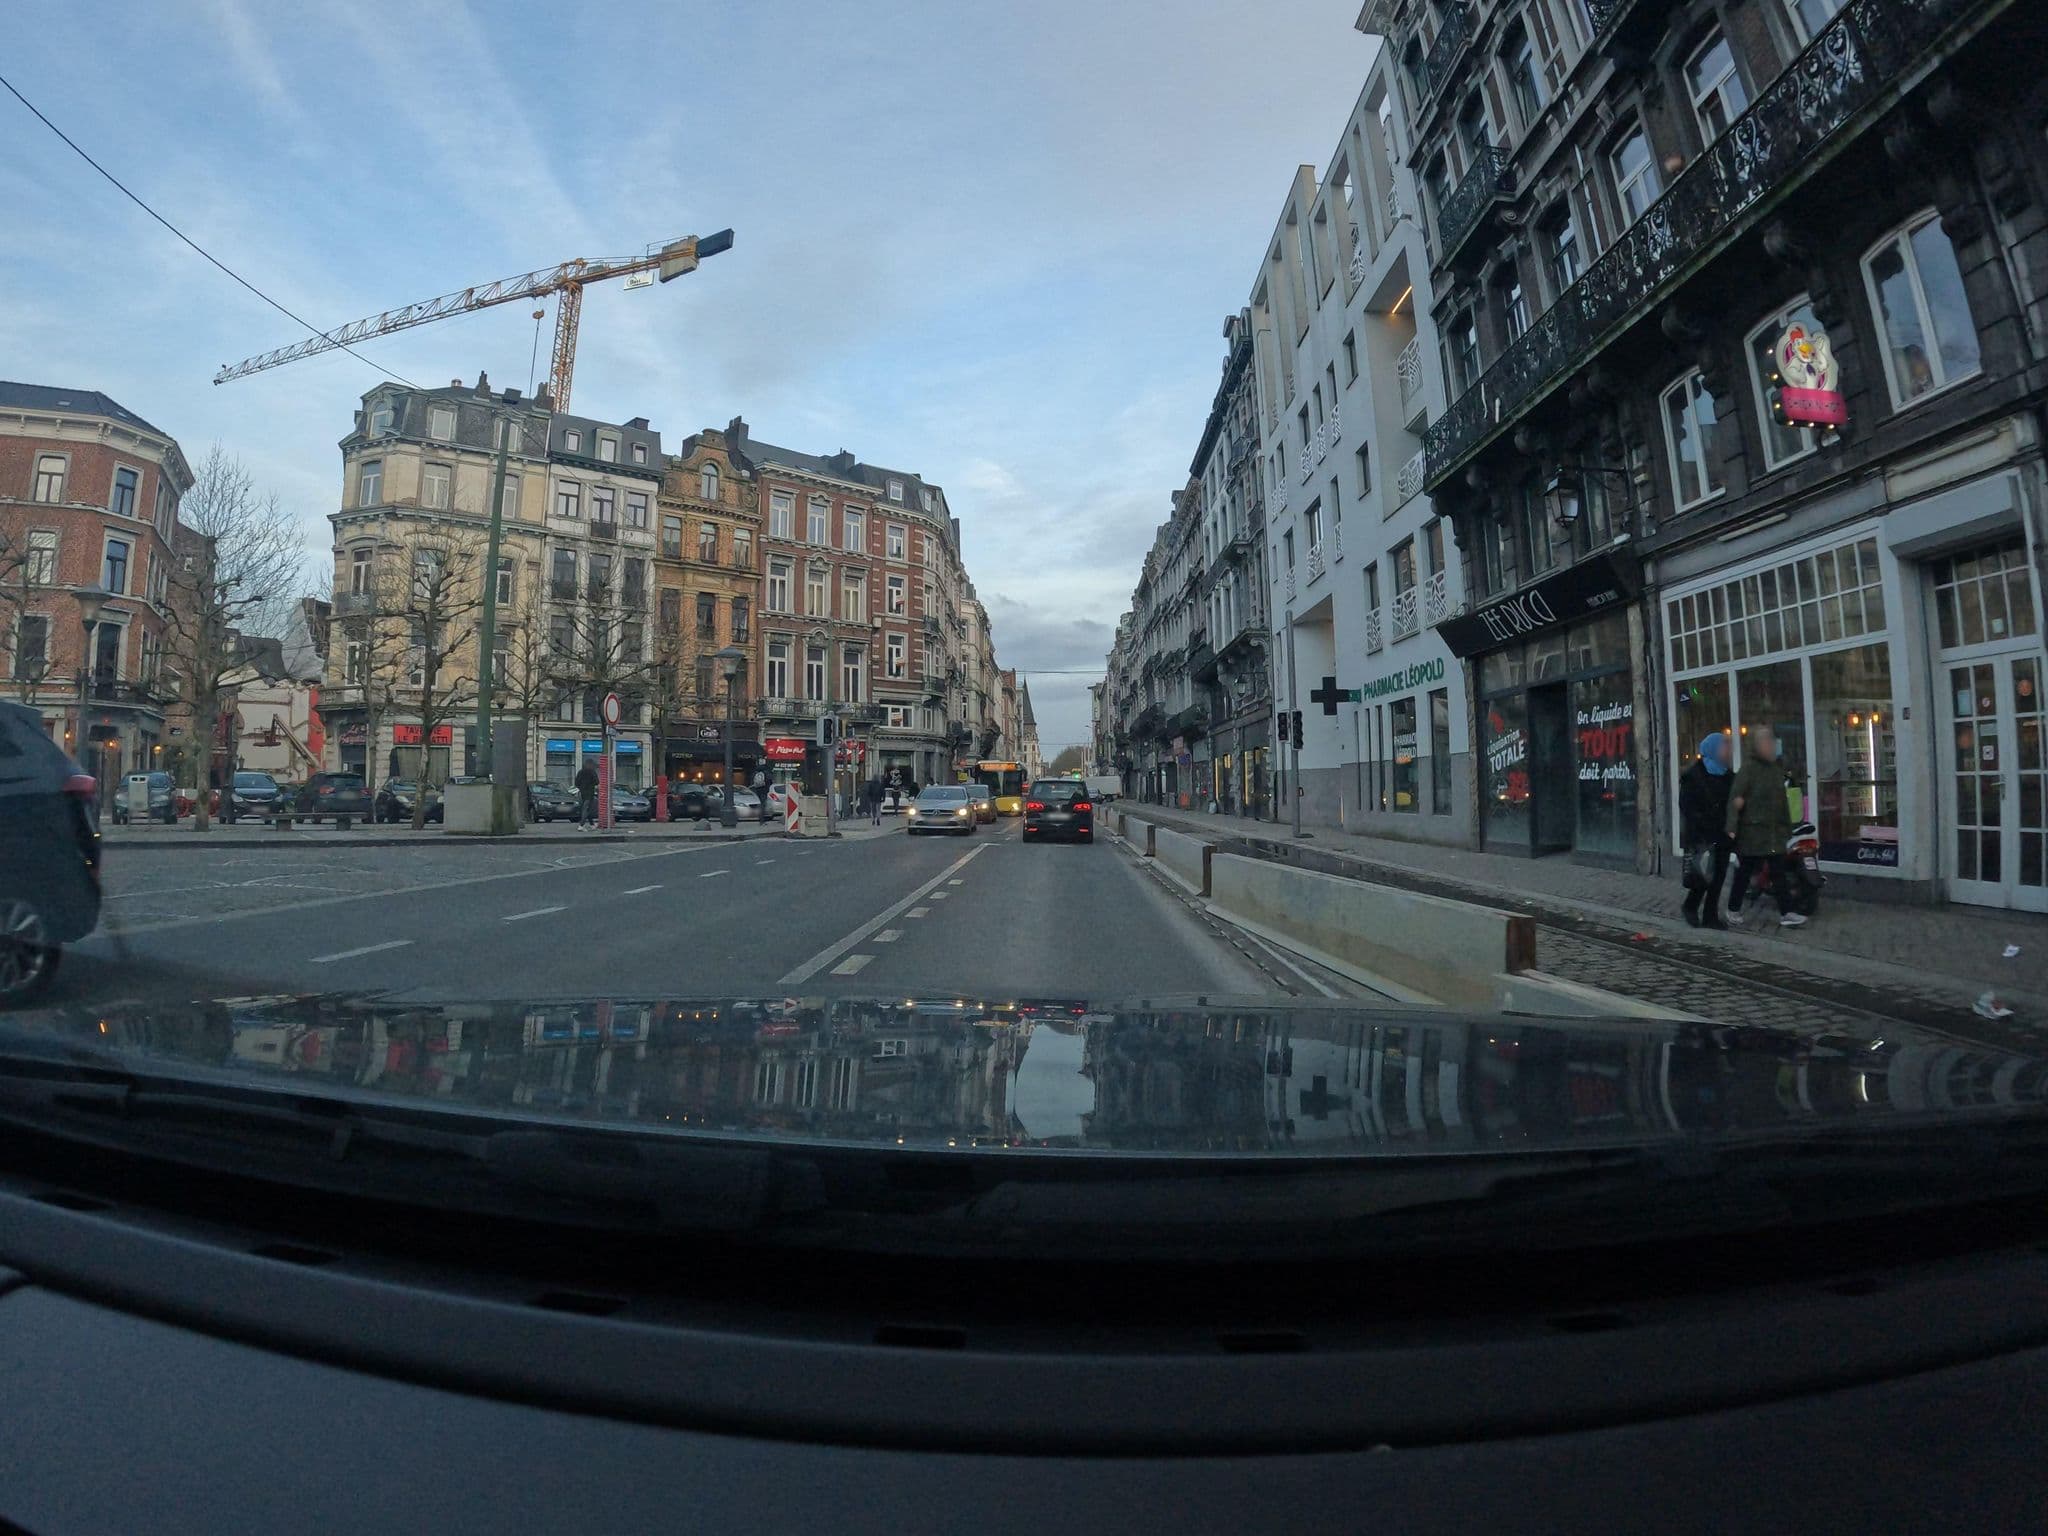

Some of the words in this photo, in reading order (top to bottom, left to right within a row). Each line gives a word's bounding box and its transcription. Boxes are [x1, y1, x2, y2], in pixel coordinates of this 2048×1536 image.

[1363, 671, 1404, 700] PHARMACIE
[1404, 657, 1445, 688] LÉOPOLD
[1577, 710, 1589, 725] On
[1590, 702, 1622, 729] liquide
[1489, 739, 1525, 774] TOTALE
[1581, 724, 1630, 758] TOUT
[1579, 762, 1600, 780] doit
